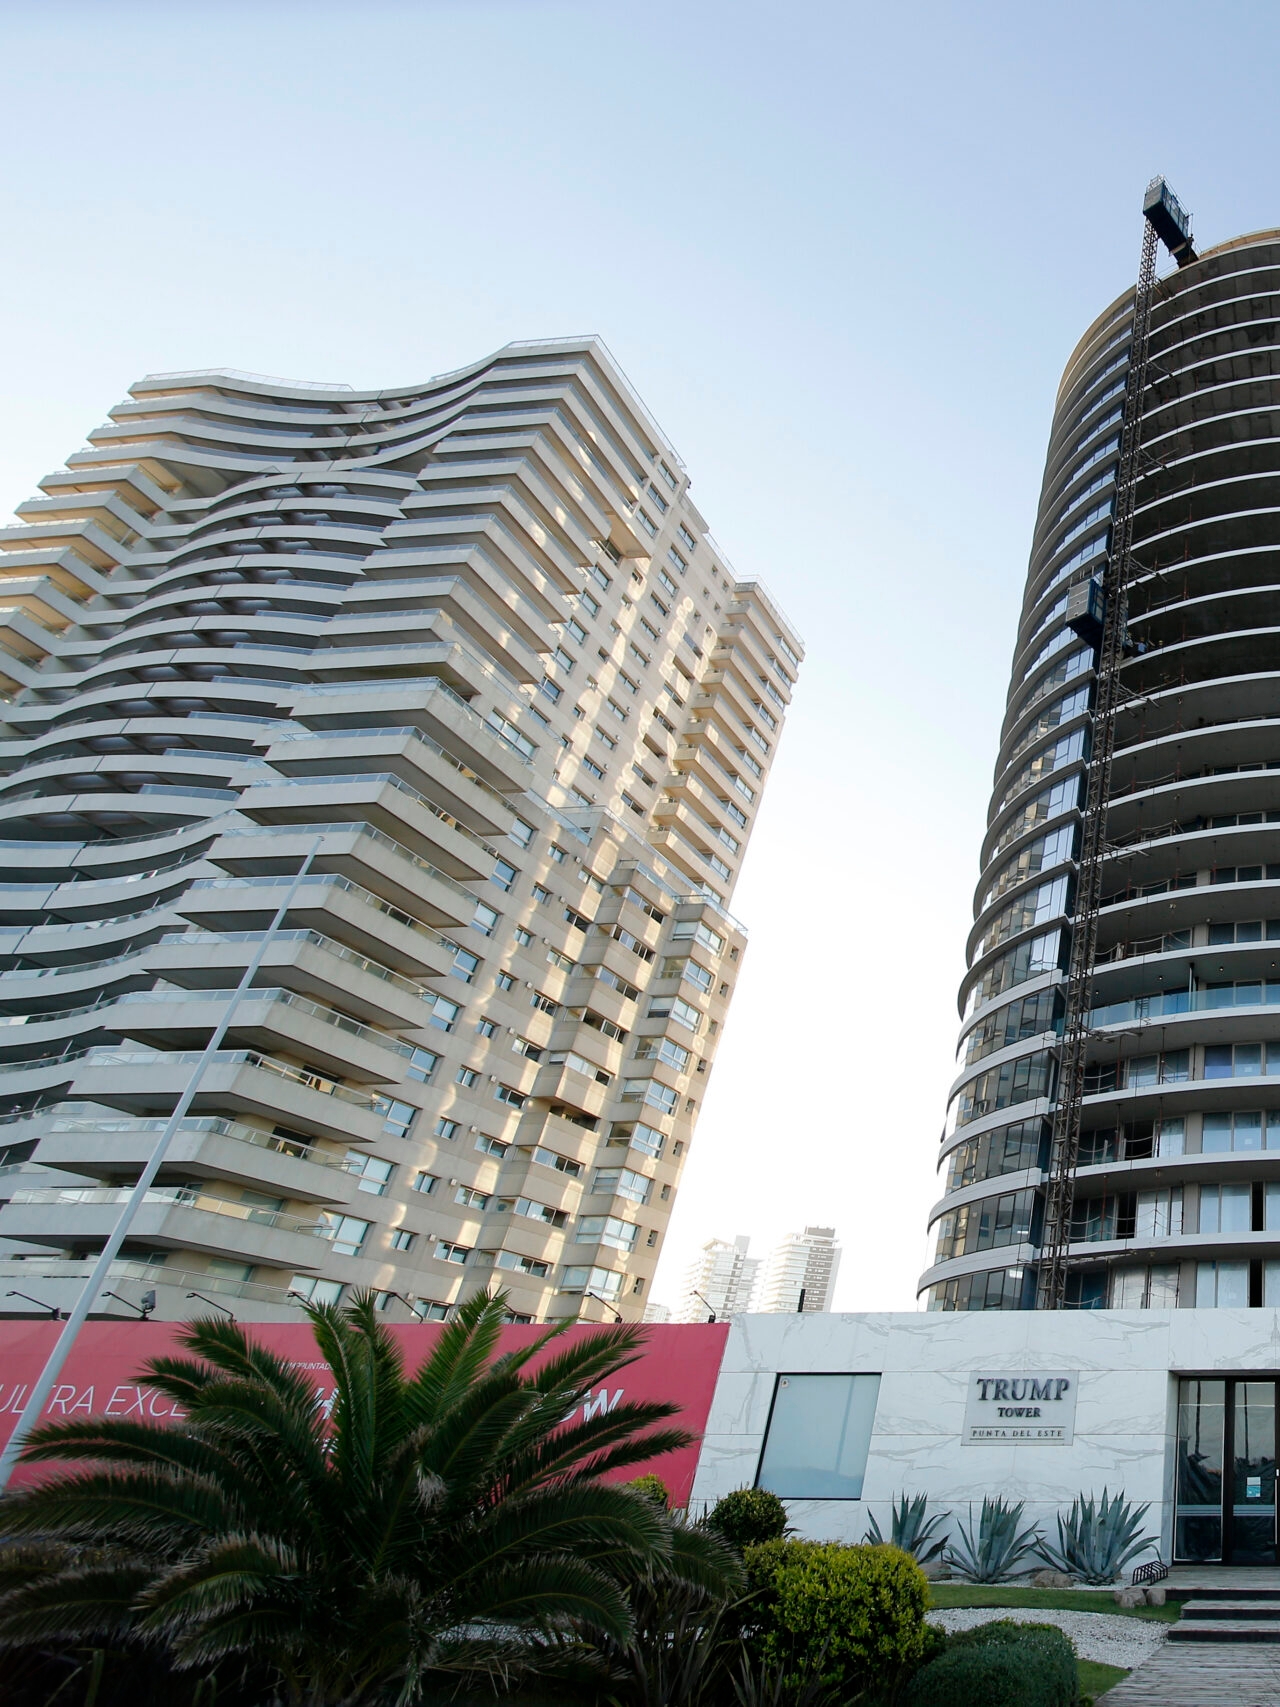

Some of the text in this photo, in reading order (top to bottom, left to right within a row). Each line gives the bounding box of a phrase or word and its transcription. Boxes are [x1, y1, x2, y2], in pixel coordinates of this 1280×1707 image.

[0, 1385, 95, 1414] ULRA
[976, 1378, 1070, 1401] TRUMP
[997, 1407, 1041, 1417] TOWER
